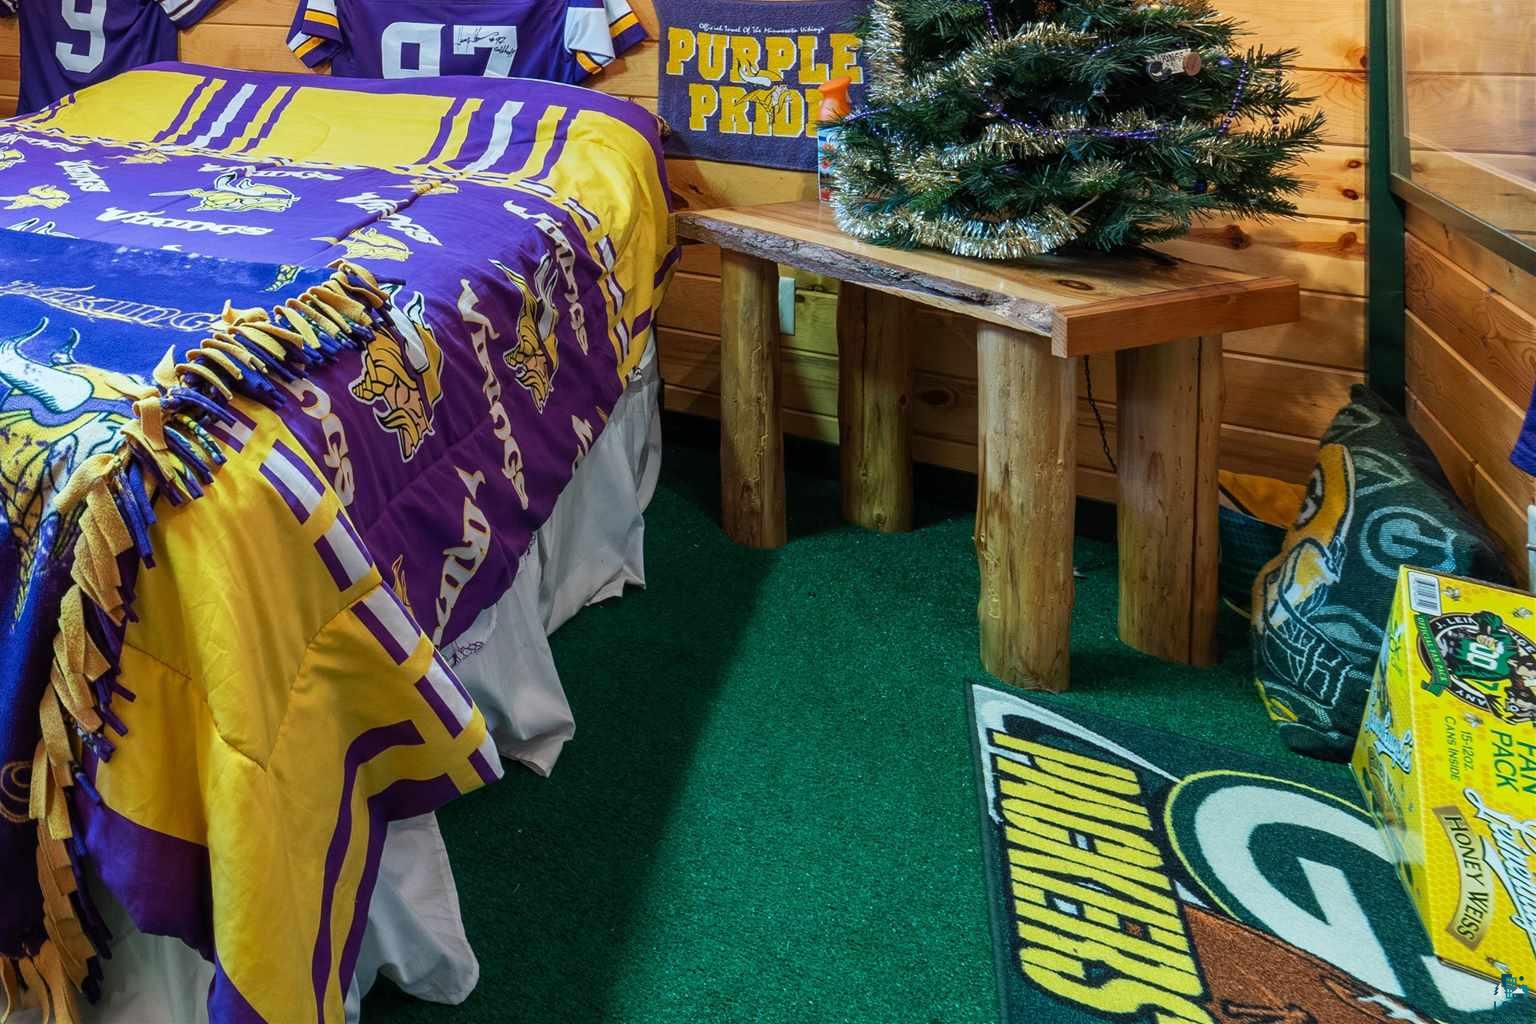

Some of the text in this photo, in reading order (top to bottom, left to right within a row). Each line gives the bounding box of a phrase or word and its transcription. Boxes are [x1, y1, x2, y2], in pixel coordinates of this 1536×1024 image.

[666, 26, 864, 85] PURPLE
[95, 206, 275, 236] VIKINGS
[1417, 616, 1434, 650] OFFICIAL
[1467, 640, 1505, 670] 00
[1444, 715, 1461, 781] CANS INSIDE
[1490, 730, 1519, 791] PACK
[1516, 742, 1536, 796] FAN
[990, 731, 1220, 1024] PACKERS
[1444, 815, 1490, 942] HONEY WEISS
